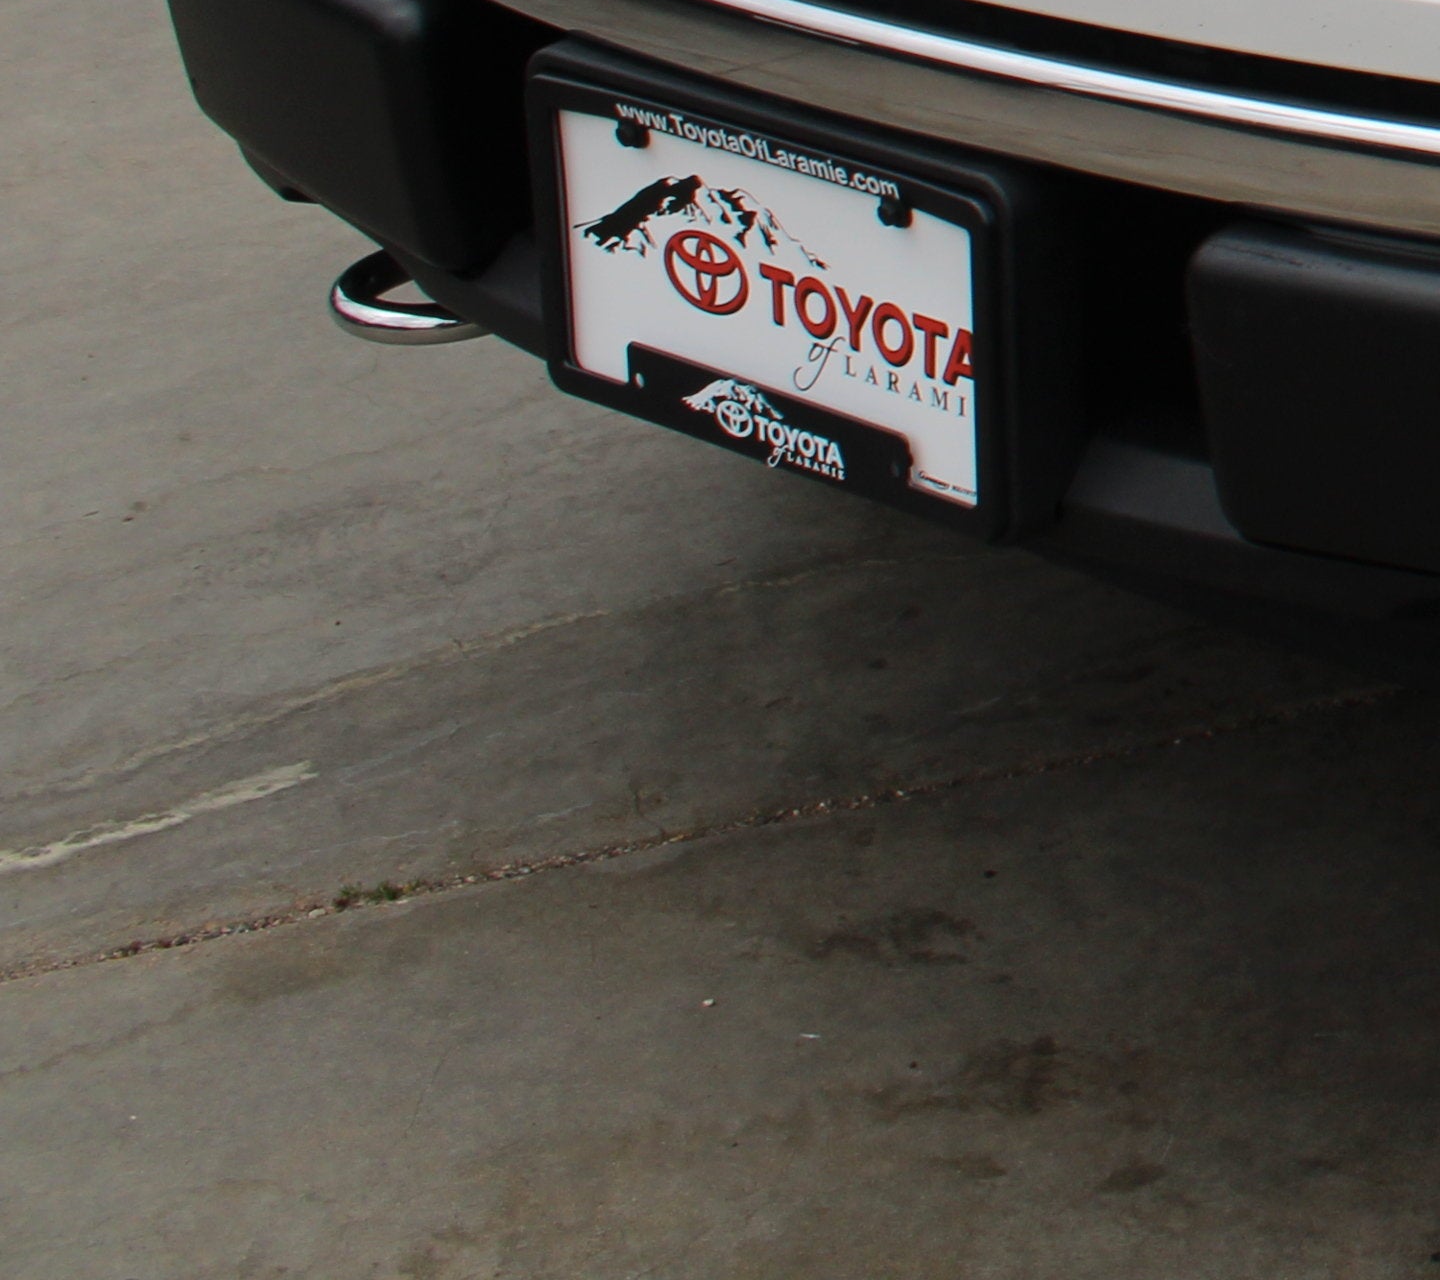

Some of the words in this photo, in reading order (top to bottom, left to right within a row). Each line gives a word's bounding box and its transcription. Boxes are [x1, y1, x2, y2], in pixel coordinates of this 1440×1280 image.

[615, 101, 900, 200] www.ToyotaOfLaramie.com
[758, 261, 976, 387] TOYOTA
[793, 335, 846, 392] of
[845, 354, 970, 418] LARAMI
[754, 414, 845, 469] TOYOTA
[787, 451, 846, 481] LARAMIE
